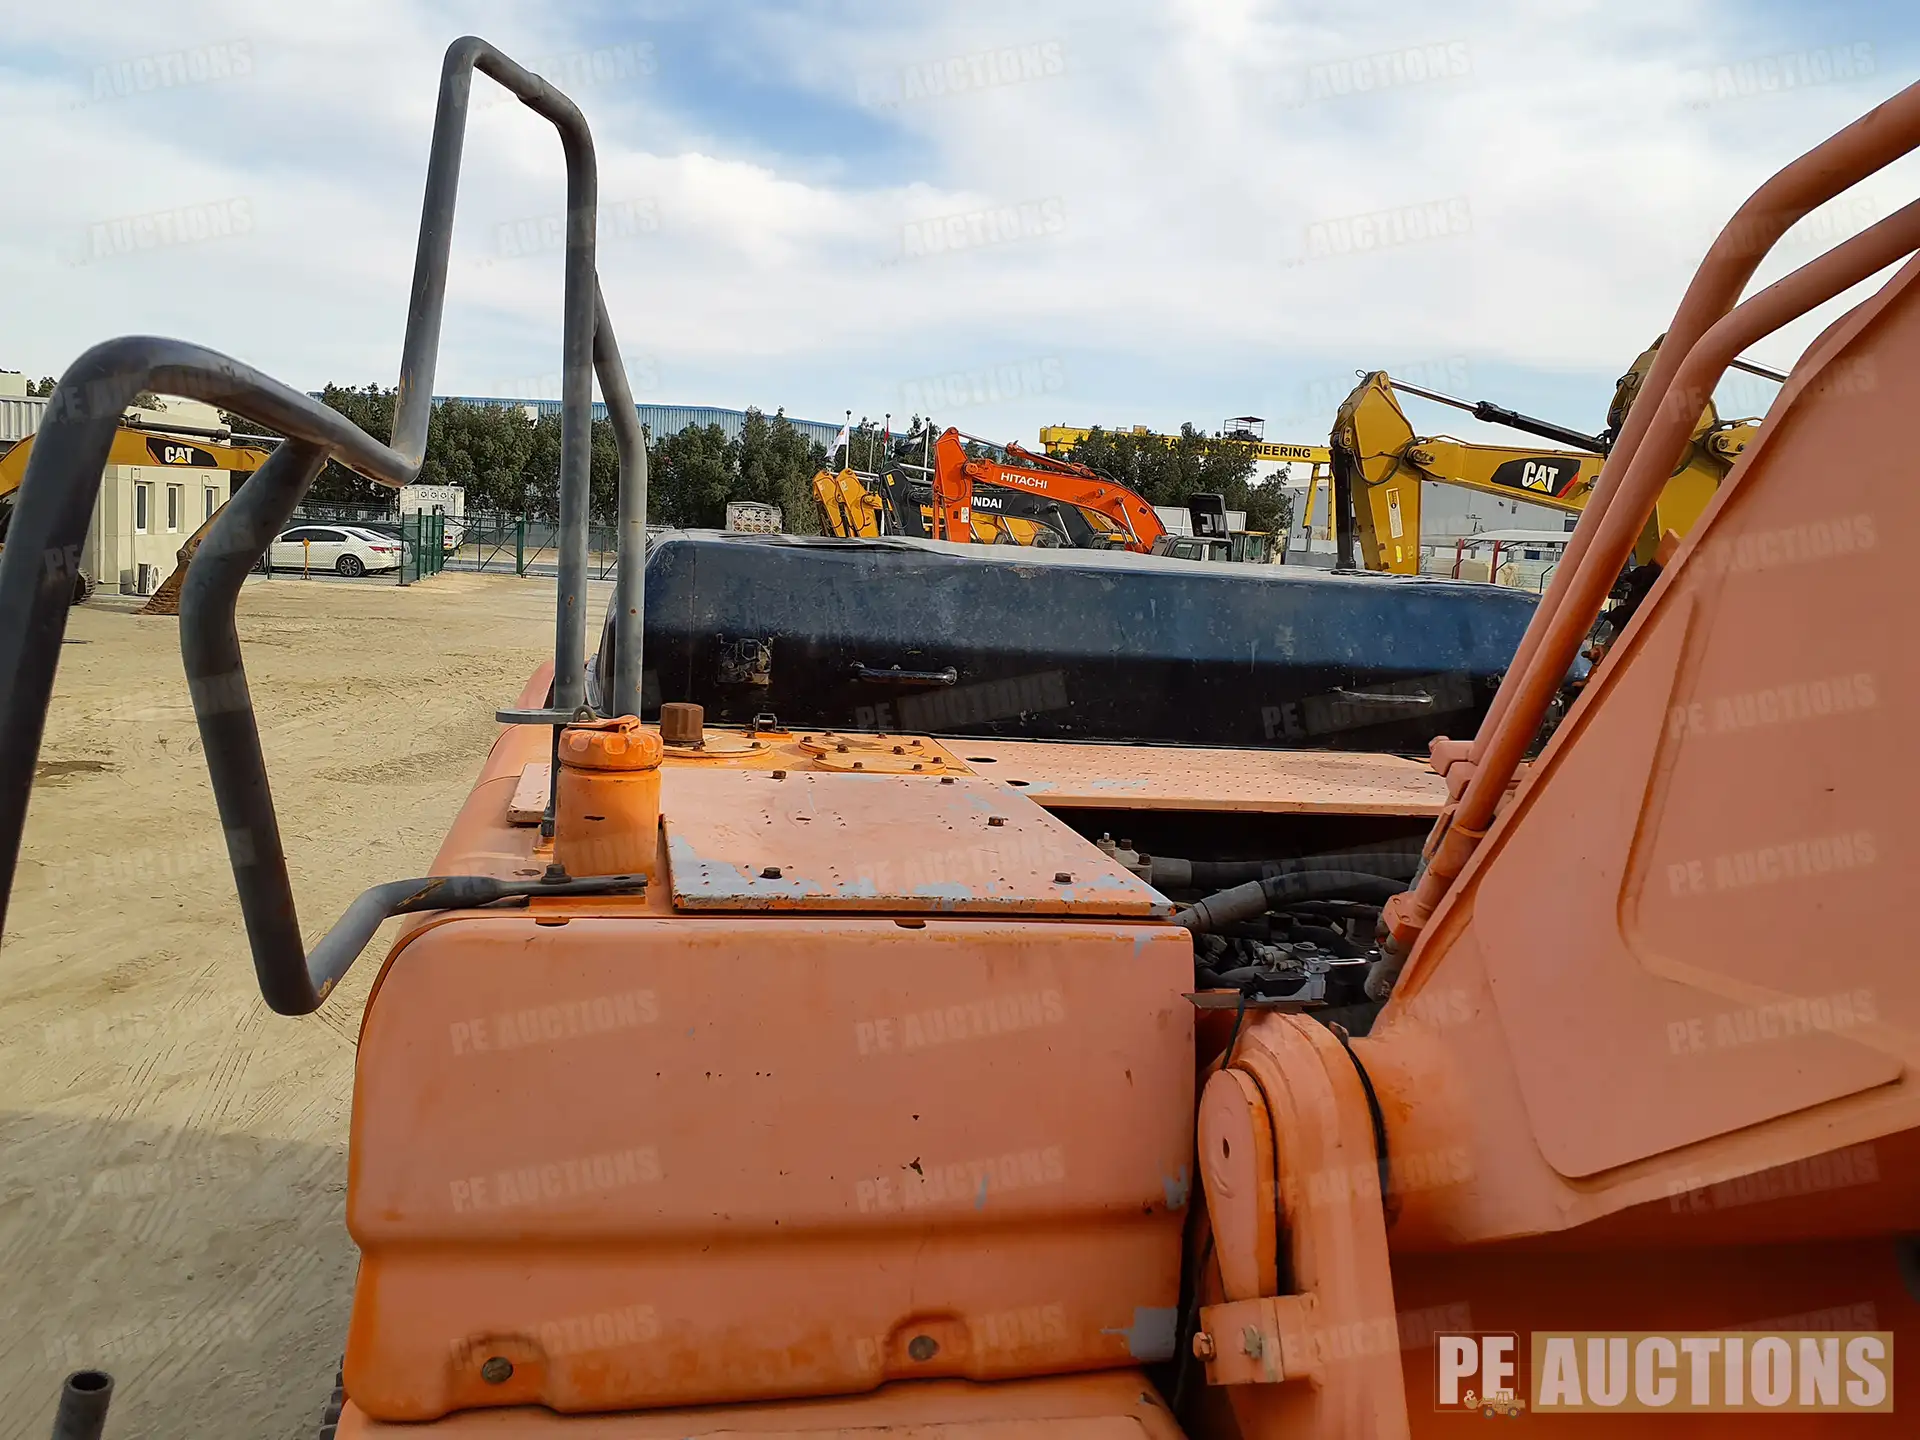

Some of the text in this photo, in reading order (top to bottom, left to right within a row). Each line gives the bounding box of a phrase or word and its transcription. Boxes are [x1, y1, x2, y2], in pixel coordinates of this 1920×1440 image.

[164, 446, 195, 465] CAT
[1235, 442, 1312, 459] GNEERING
[1000, 472, 1048, 489] HITACHI
[1521, 461, 1559, 493] CAT
[971, 496, 1003, 509] NDAI
